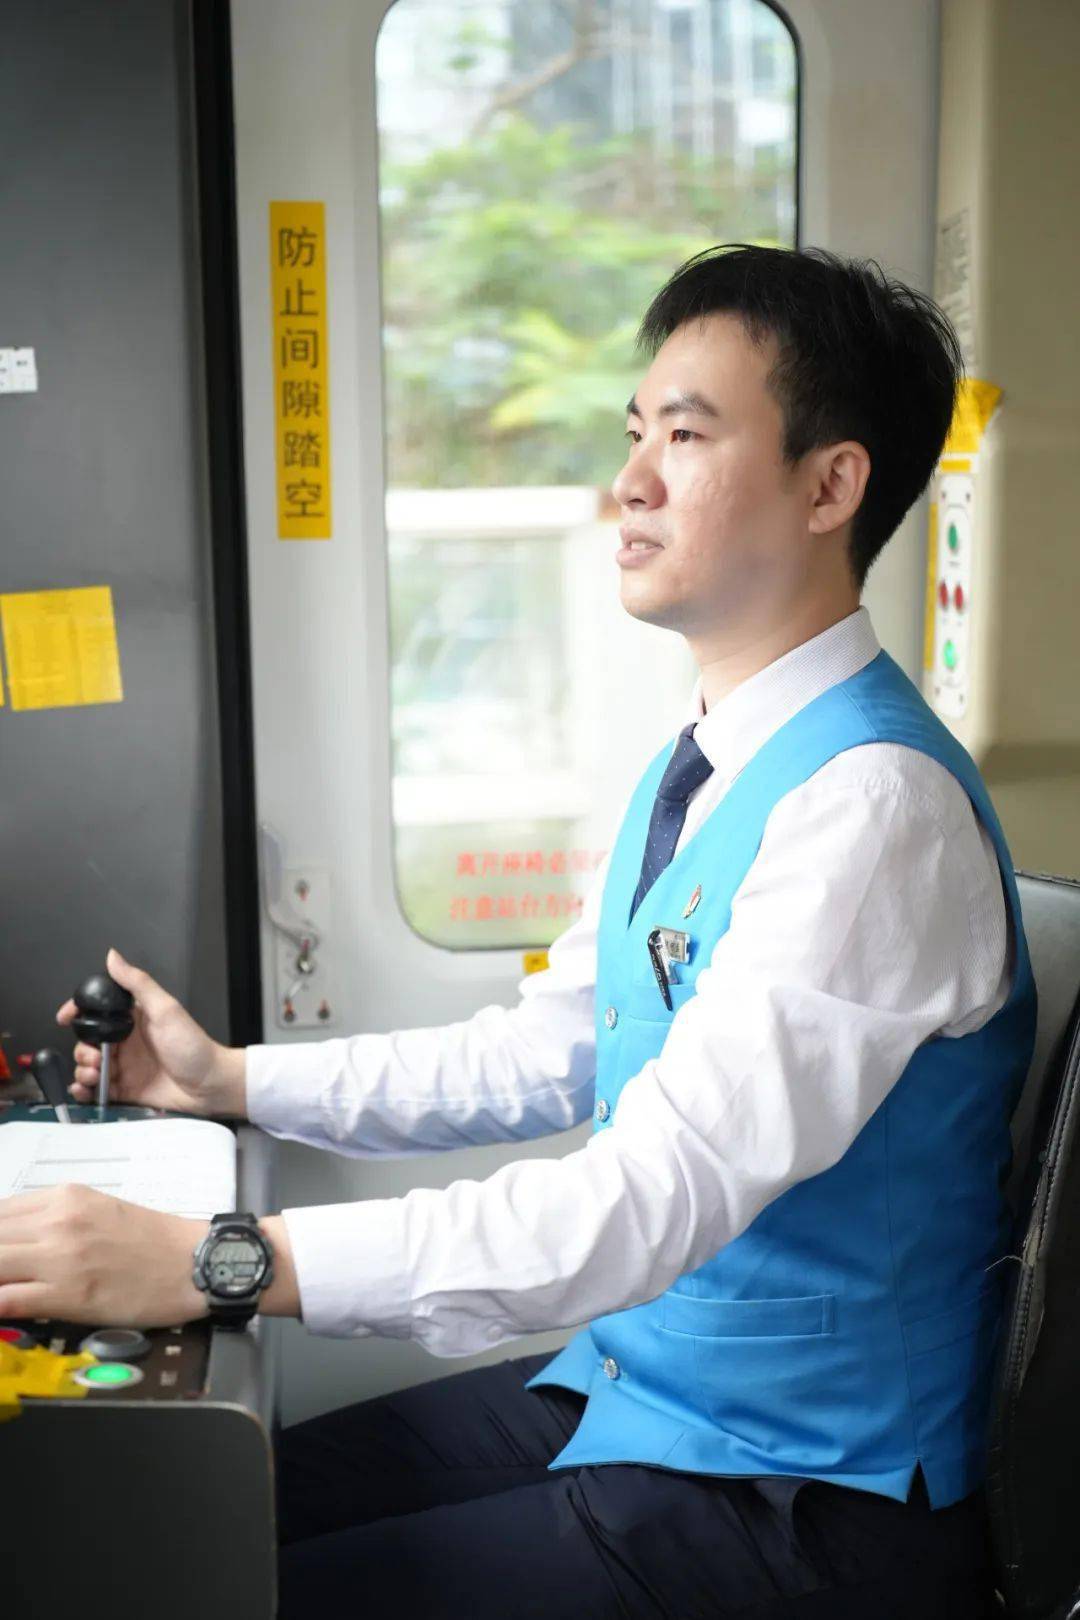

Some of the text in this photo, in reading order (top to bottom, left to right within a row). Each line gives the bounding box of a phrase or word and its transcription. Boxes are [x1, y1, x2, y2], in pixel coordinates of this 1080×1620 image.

[277, 225, 325, 519] 防止间隙踏空
